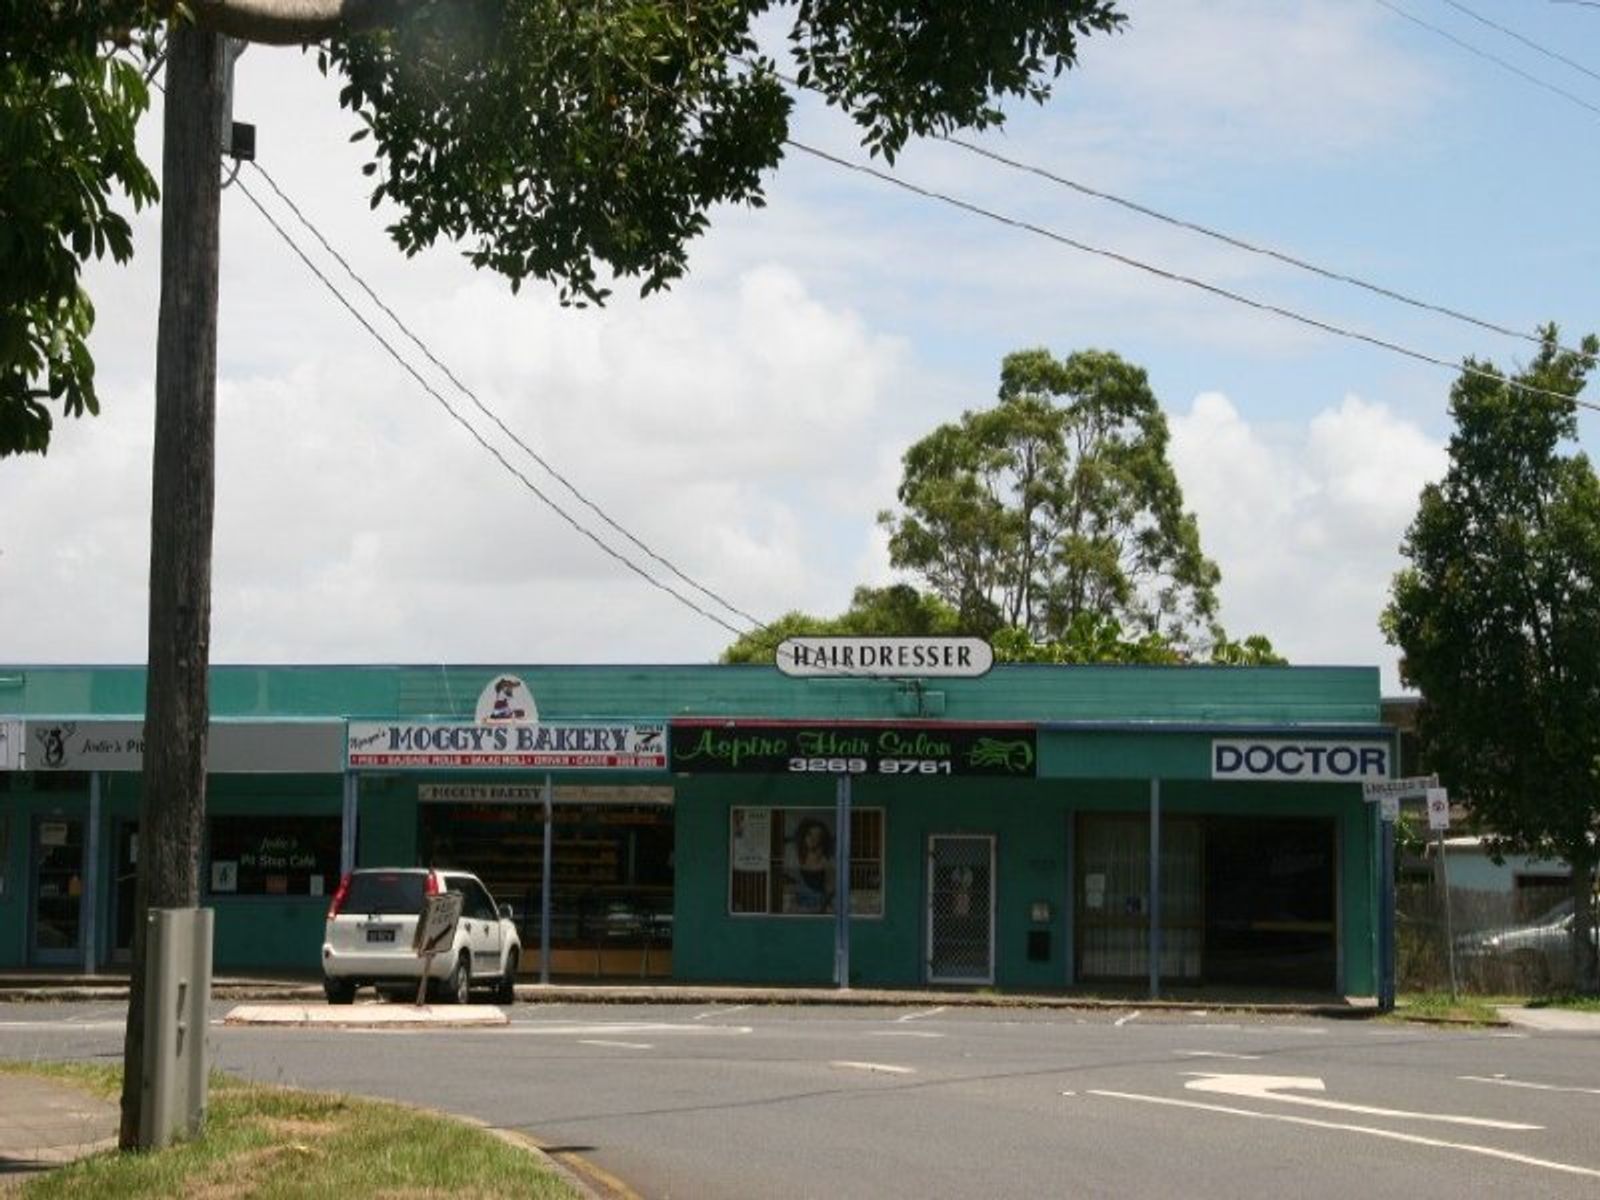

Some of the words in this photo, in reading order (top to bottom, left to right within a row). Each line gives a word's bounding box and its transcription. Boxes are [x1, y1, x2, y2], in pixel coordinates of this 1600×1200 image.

[793, 645, 972, 669] HAIRDRESSER
[388, 726, 508, 751] MOGGY'S
[517, 727, 629, 752] BAKERY
[799, 731, 871, 758] Hair
[877, 731, 953, 757] Salon
[788, 757, 868, 773] 3269
[1216, 745, 1386, 776] DOCTOR
